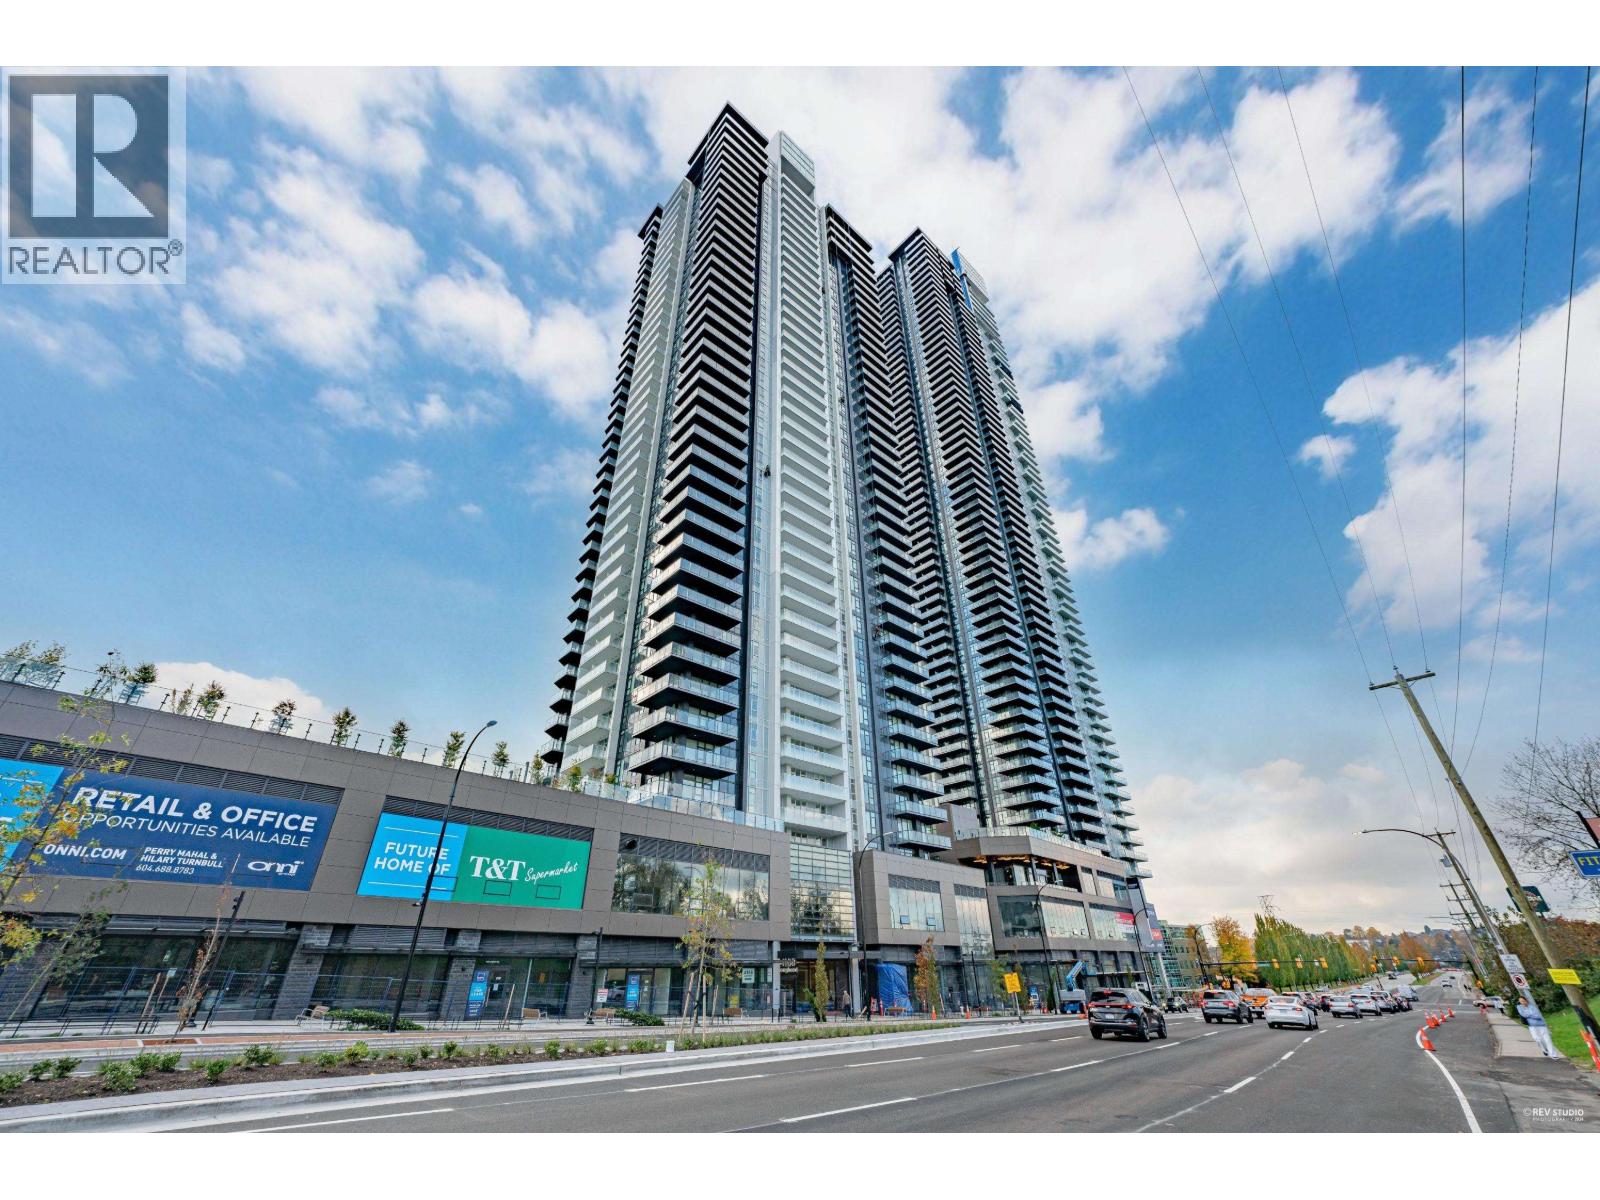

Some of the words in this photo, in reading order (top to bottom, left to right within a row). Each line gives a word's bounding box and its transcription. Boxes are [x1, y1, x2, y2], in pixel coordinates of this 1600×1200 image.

[71, 787, 184, 817] RETAIL
[192, 802, 212, 820] &
[221, 805, 318, 833] OFFICE
[62, 812, 218, 837] OPPORTUNITIES
[220, 827, 311, 848] AVAILABLE
[43, 844, 127, 860] ONNI.COM
[144, 846, 176, 856] PERRY
[177, 849, 208, 859] MAHAL
[210, 852, 217, 860] &
[384, 841, 449, 860] FUTURE
[140, 854, 176, 864] HILARY
[177, 857, 223, 868] TURNBULL
[374, 856, 425, 873] HOME
[428, 863, 451, 875] OF
[469, 855, 526, 881] T&T
[524, 860, 579, 885] Supermarket
